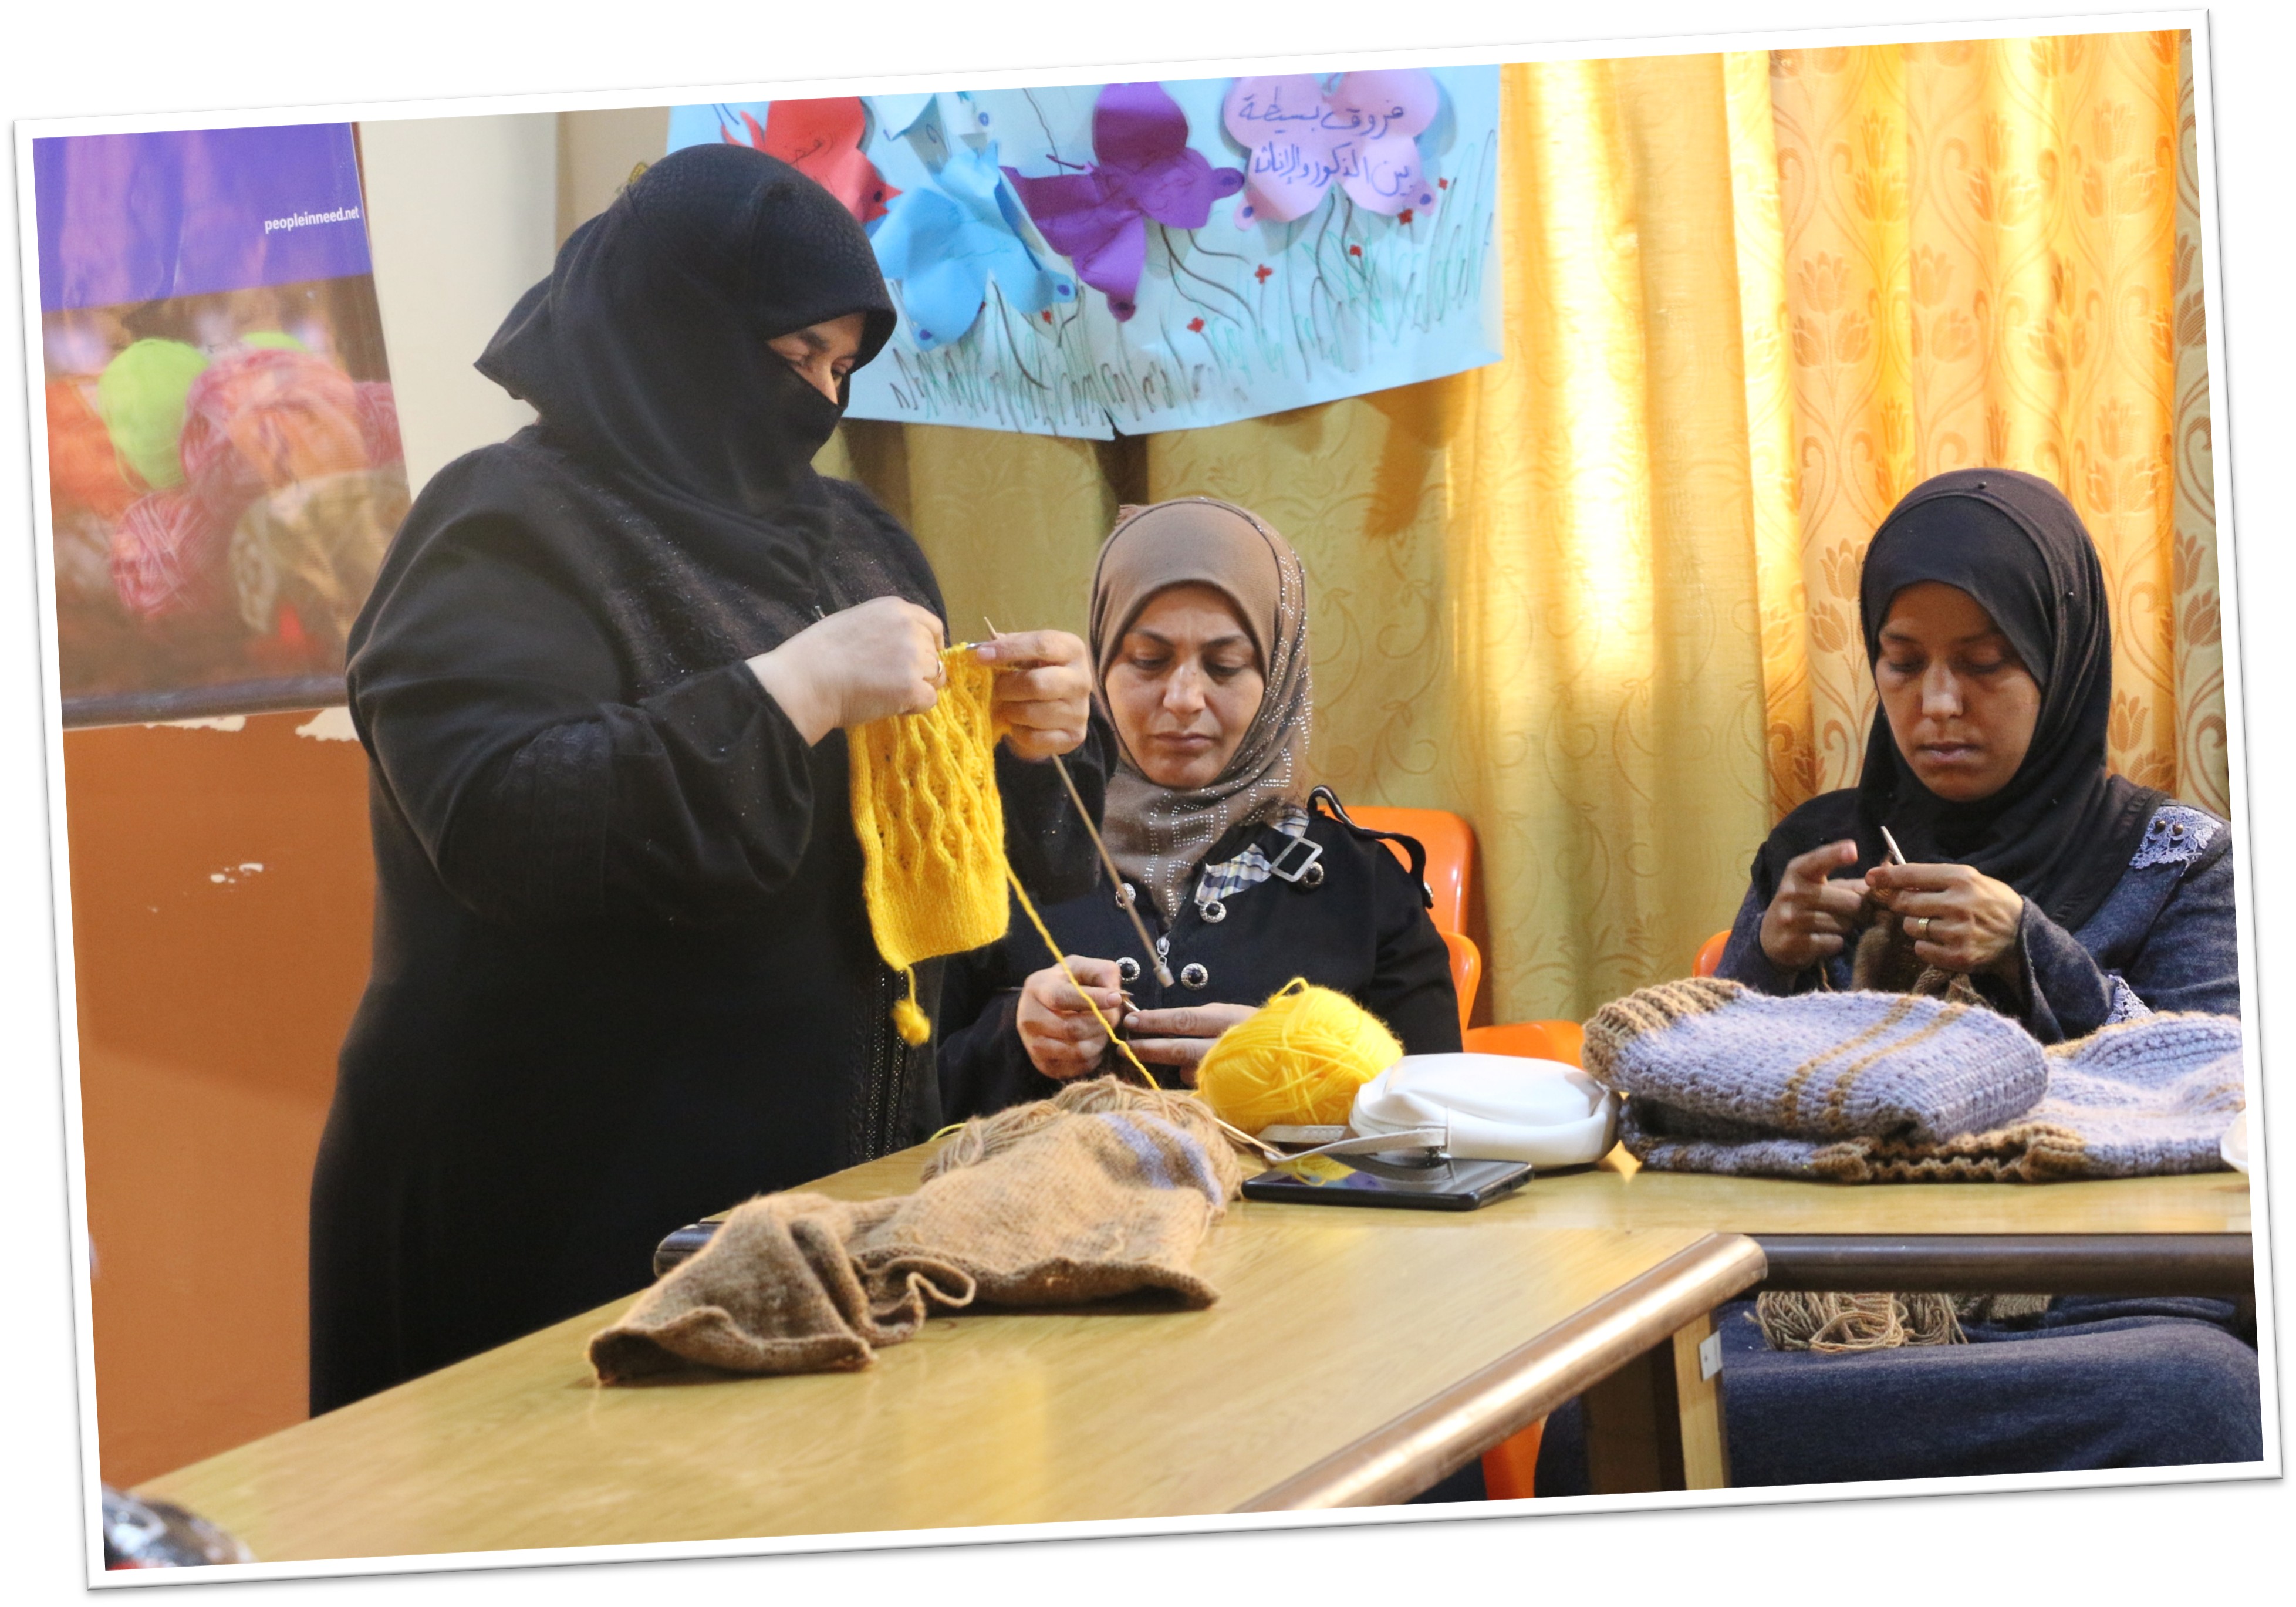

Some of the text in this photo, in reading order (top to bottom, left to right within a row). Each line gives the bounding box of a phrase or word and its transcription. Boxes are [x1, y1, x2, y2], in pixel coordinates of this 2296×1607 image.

[1238, 86, 1404, 140] فروق بسيطة
[1310, 142, 1369, 188] الذكور
[1372, 160, 1414, 197] بين
[265, 206, 359, 234] peopleinneed.net
